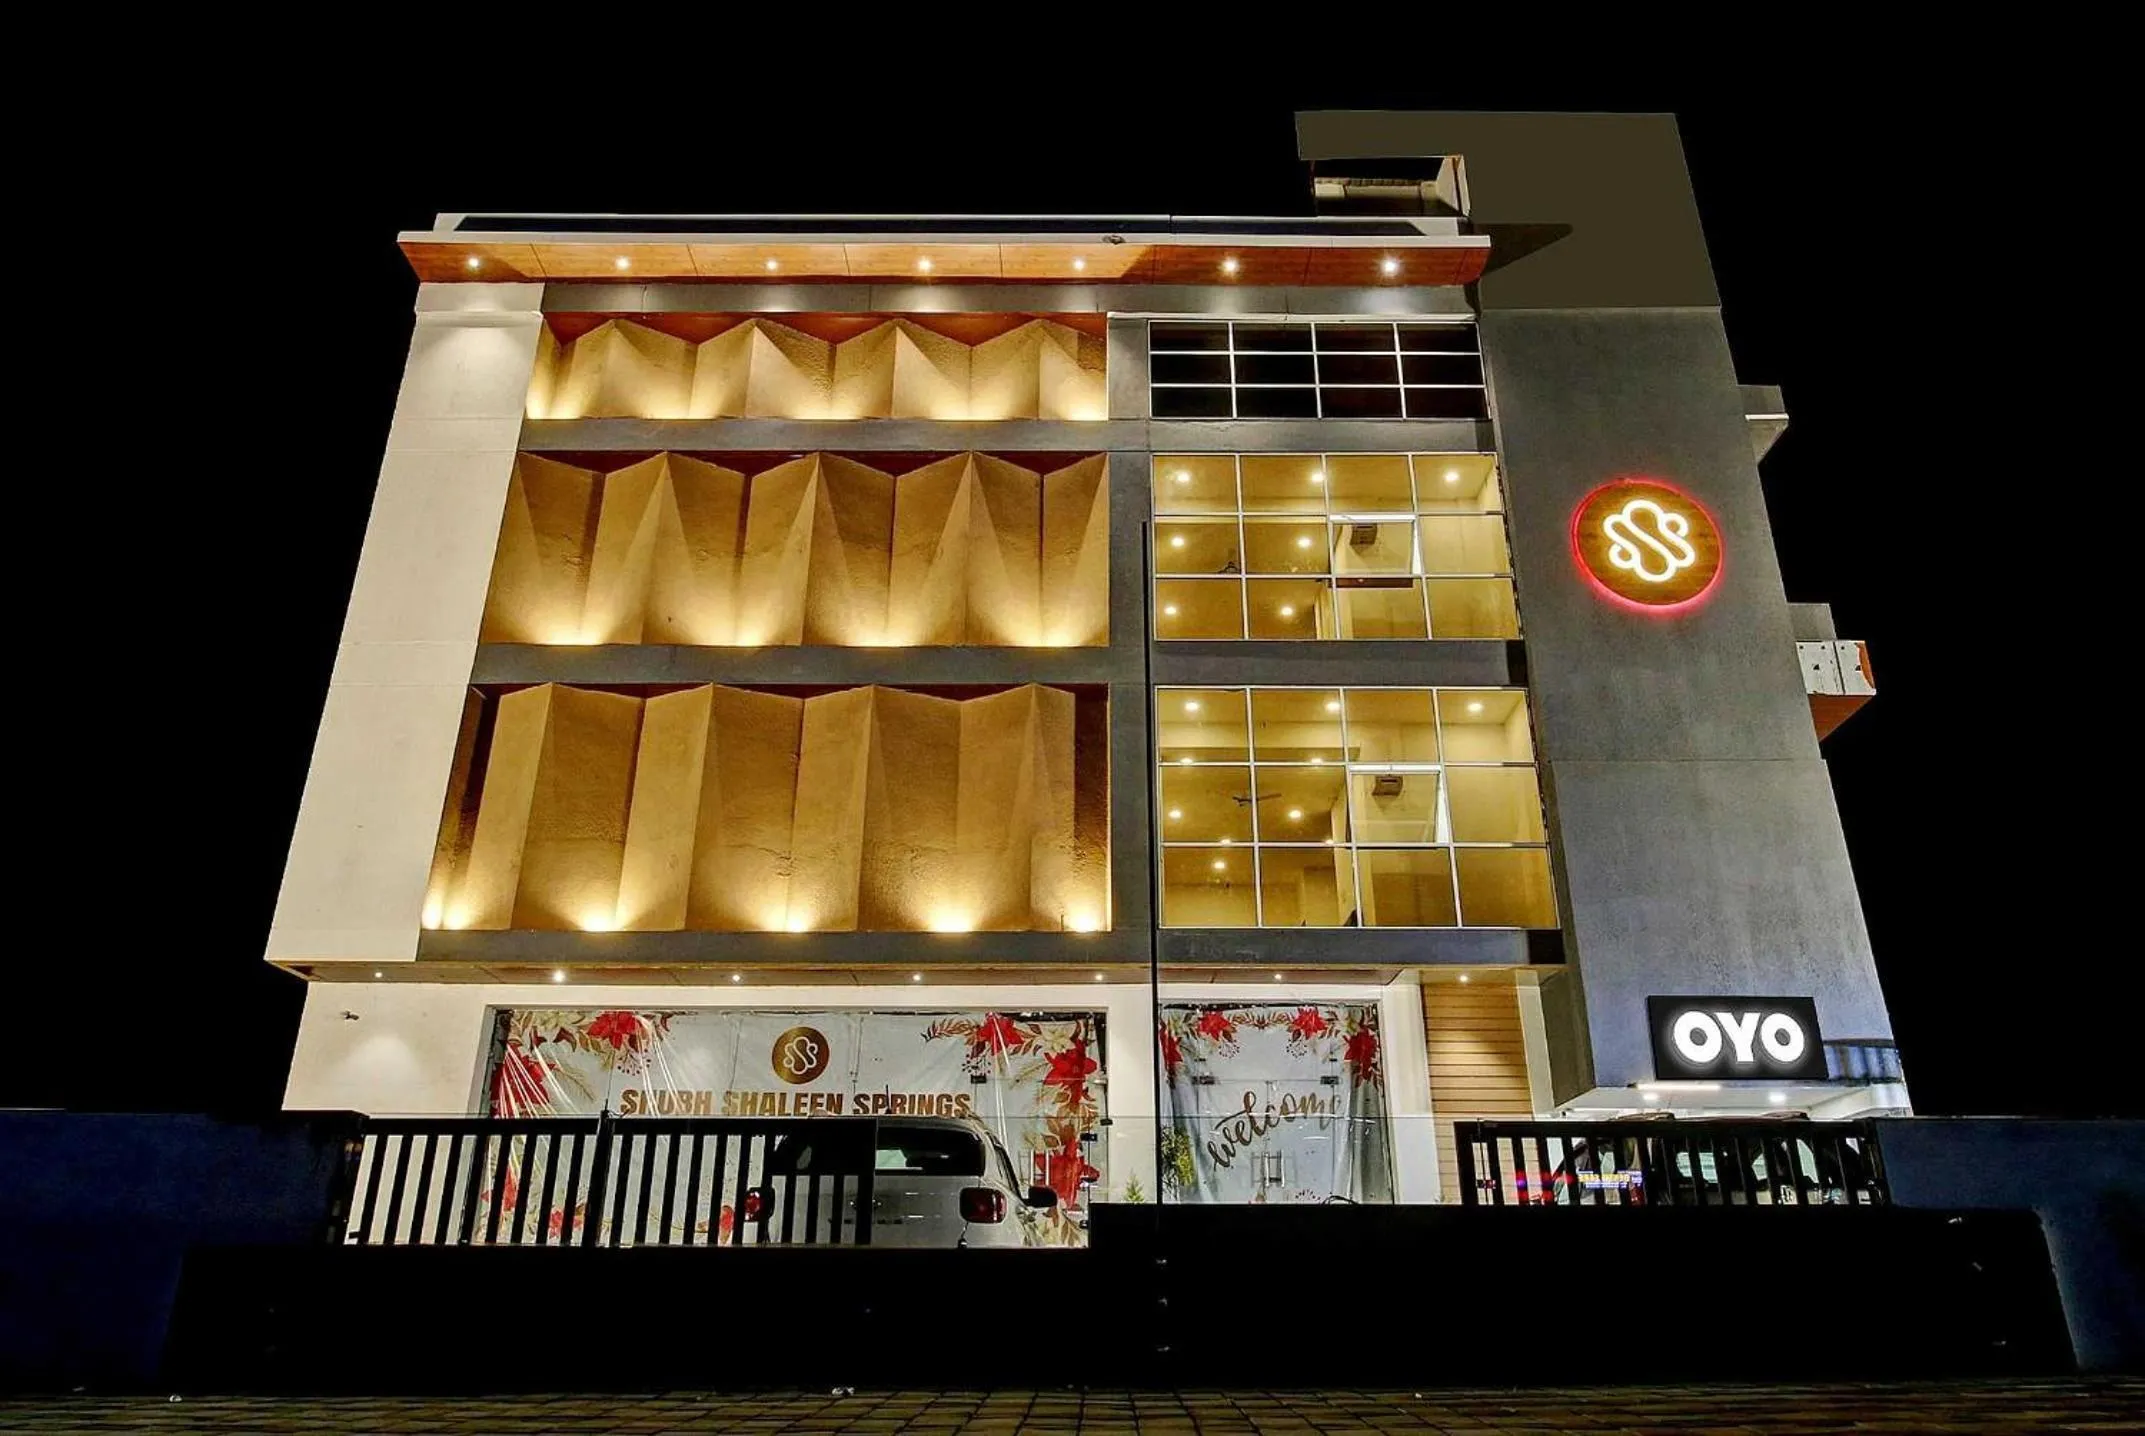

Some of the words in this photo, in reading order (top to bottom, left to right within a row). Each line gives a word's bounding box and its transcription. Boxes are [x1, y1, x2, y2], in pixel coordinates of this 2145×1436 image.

[1673, 1010, 1805, 1064] OYO
[722, 1090, 844, 1117] SHALEEN
[853, 1093, 971, 1118] SPRINGS
